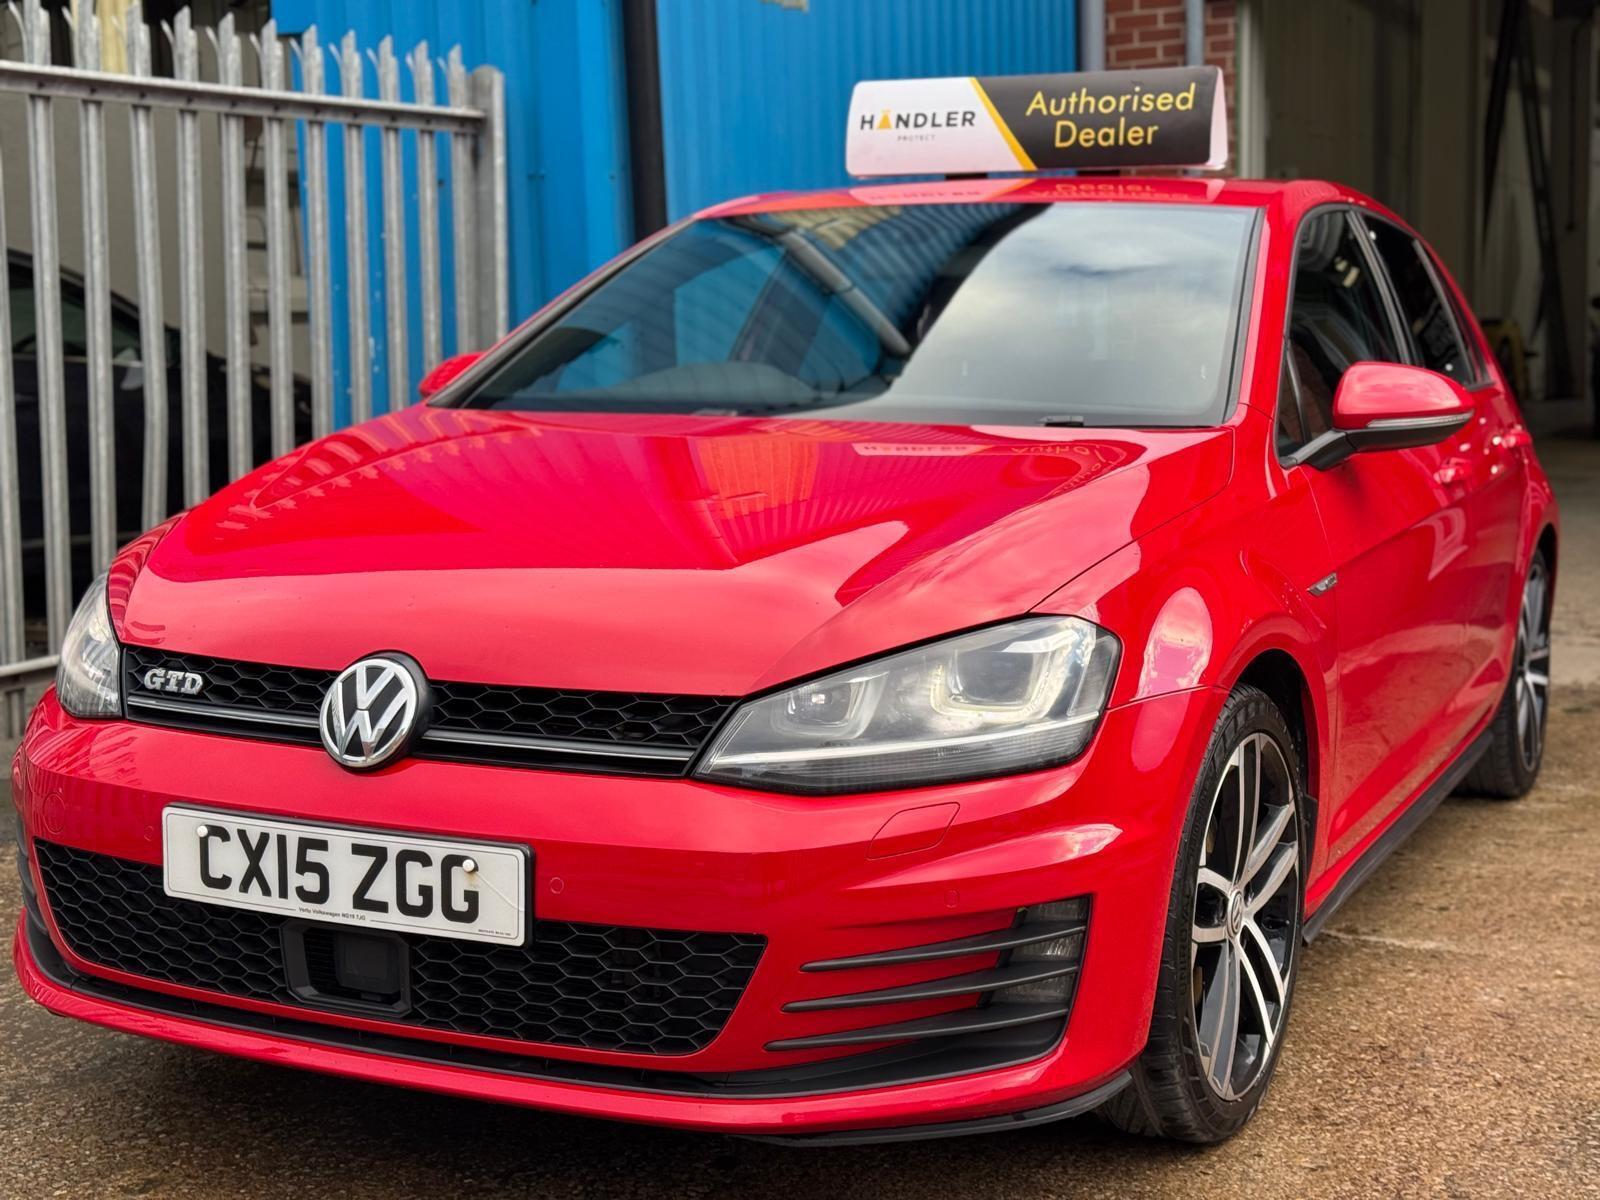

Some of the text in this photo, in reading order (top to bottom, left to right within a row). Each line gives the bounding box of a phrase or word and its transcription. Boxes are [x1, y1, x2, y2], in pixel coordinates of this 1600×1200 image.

[1025, 82, 1196, 117] Authorised
[897, 134, 936, 142] PROTECT
[1054, 117, 1158, 149] Dealer
[143, 667, 204, 696] GTD
[322, 660, 416, 766] VW
[200, 823, 479, 924] CX15 ZGG
